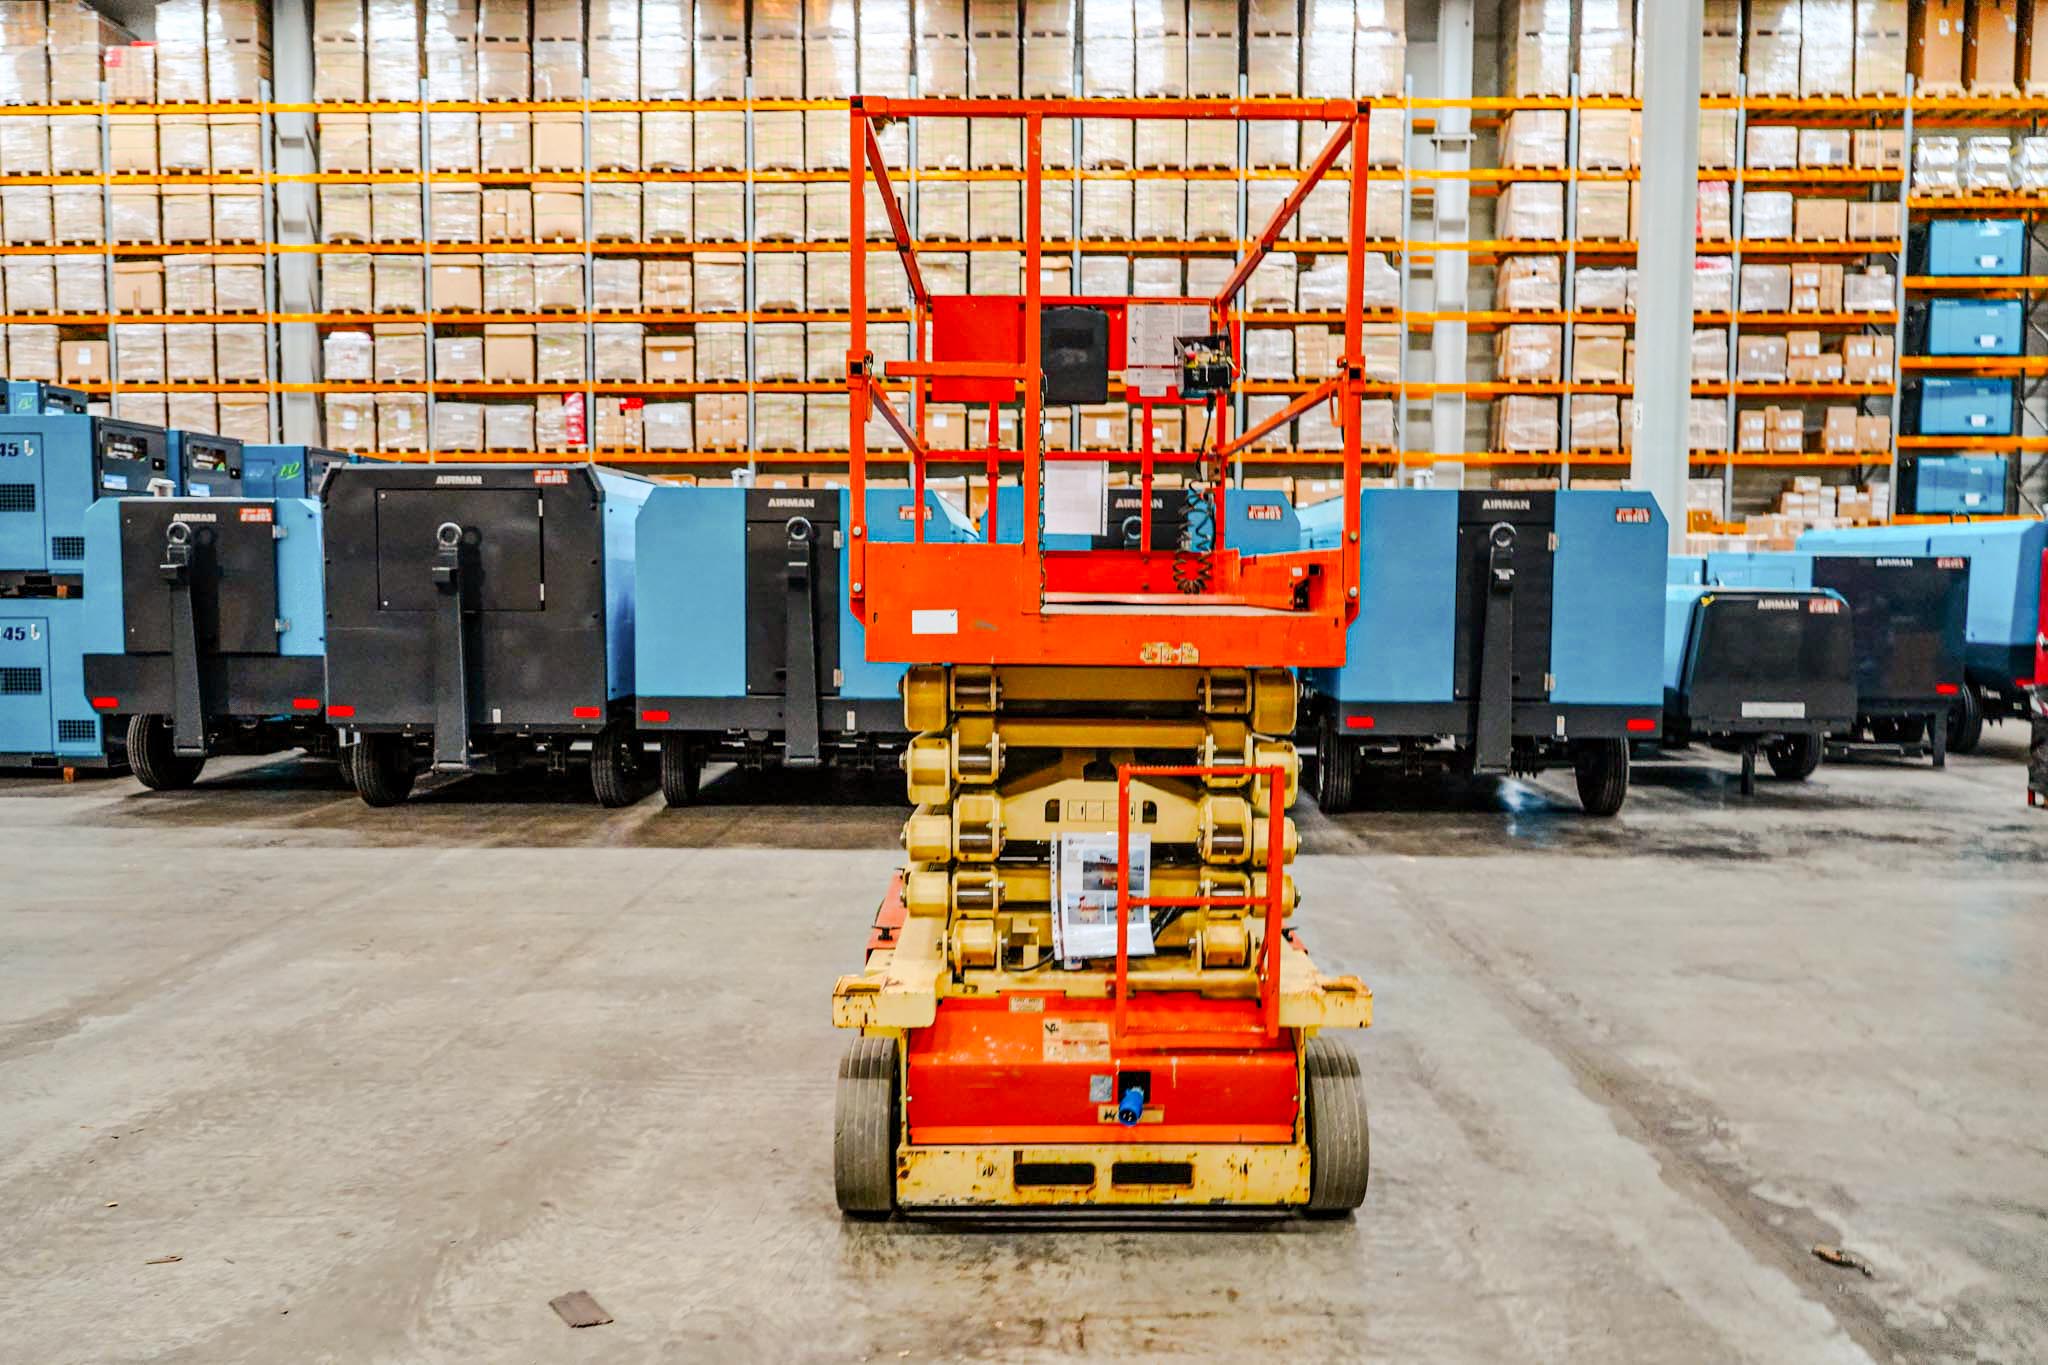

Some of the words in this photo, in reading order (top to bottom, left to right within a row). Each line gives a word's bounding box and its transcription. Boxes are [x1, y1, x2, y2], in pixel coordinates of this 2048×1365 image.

[435, 476, 481, 484] AIRMAN
[768, 498, 814, 508] AIRMAN
[1115, 498, 1163, 509] AIRMN
[1482, 500, 1530, 510] AIRMAN
[173, 513, 216, 522] AIRMAN
[1876, 559, 1913, 567] AIRMAN
[1757, 600, 1799, 609] AIRMAN
